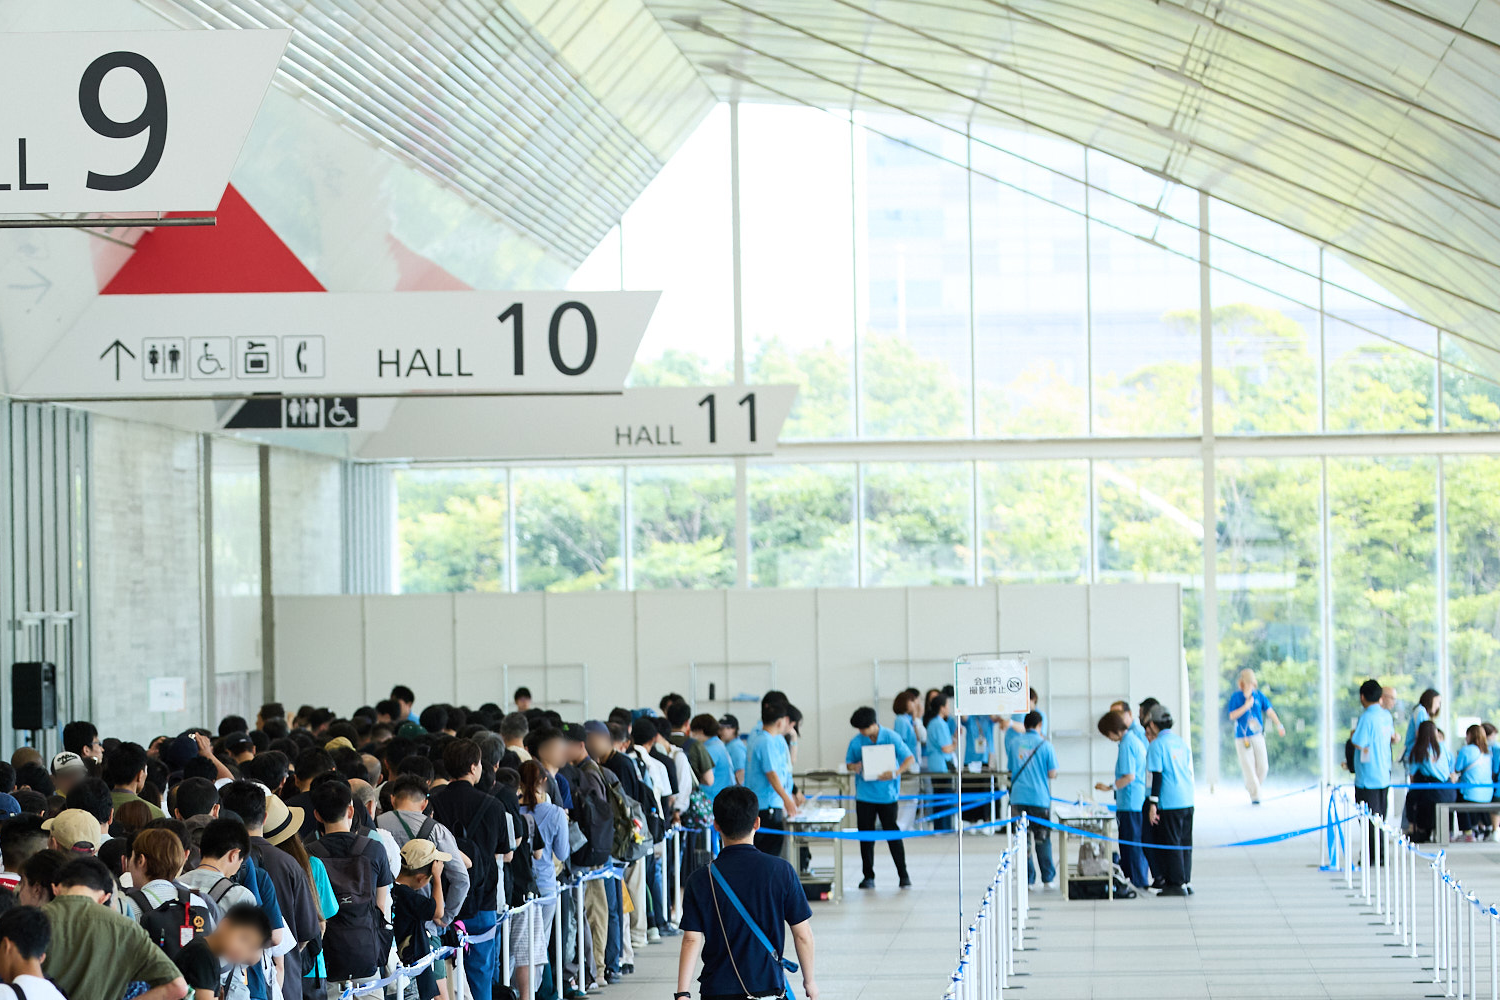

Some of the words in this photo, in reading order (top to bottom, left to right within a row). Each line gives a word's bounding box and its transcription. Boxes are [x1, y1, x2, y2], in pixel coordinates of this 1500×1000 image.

[78, 50, 168, 192] 9
[377, 348, 474, 378] HALL
[497, 301, 598, 376] 10
[615, 425, 683, 446] HALL
[698, 393, 758, 444] 11
